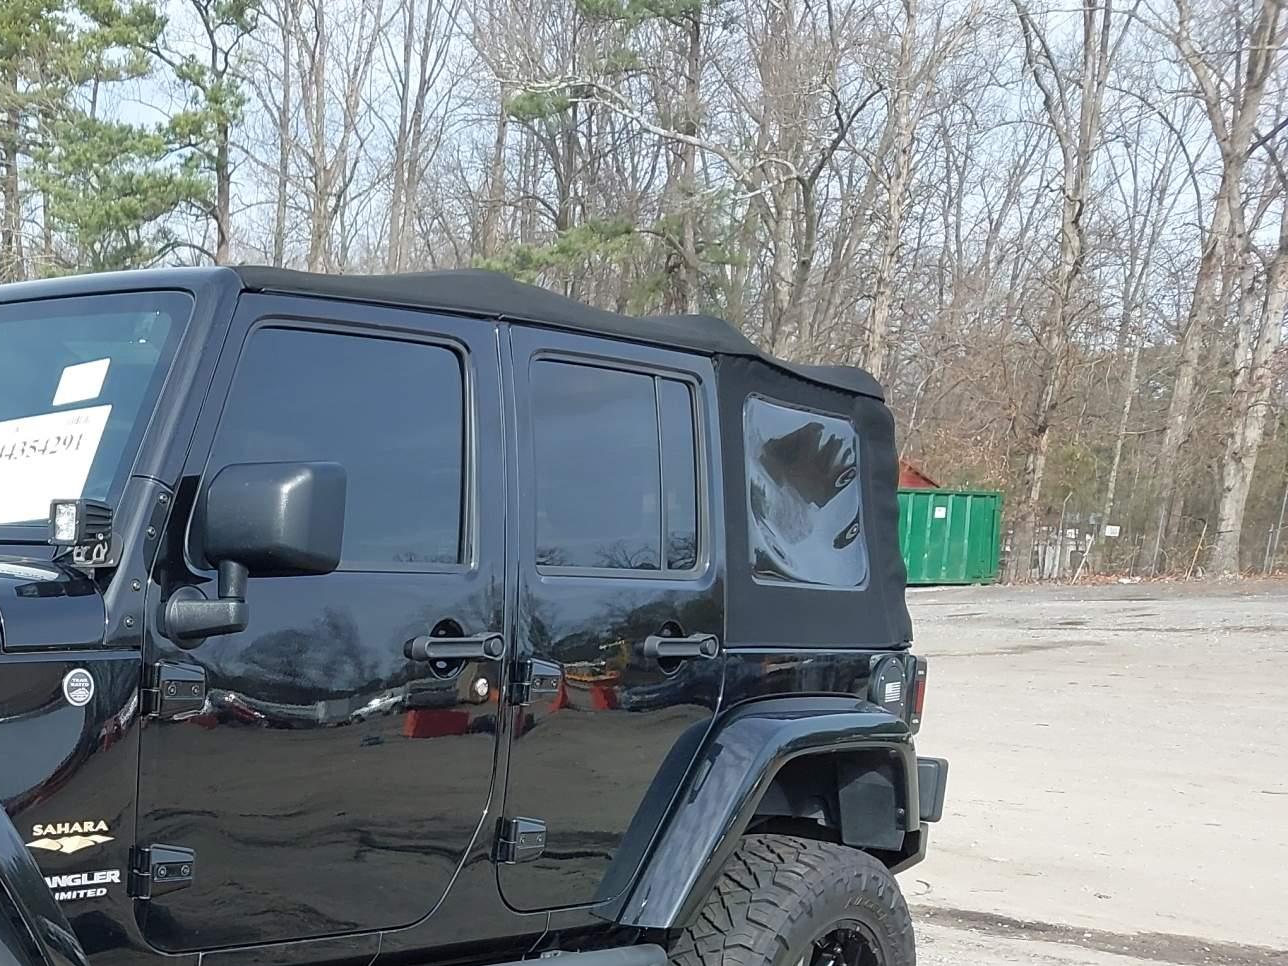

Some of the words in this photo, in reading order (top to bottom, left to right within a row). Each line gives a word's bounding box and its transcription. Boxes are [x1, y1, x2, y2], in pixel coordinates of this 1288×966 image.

[32, 820, 109, 836] SAHARA
[44, 869, 121, 889] ANGLER
[54, 887, 108, 901] IMITED
